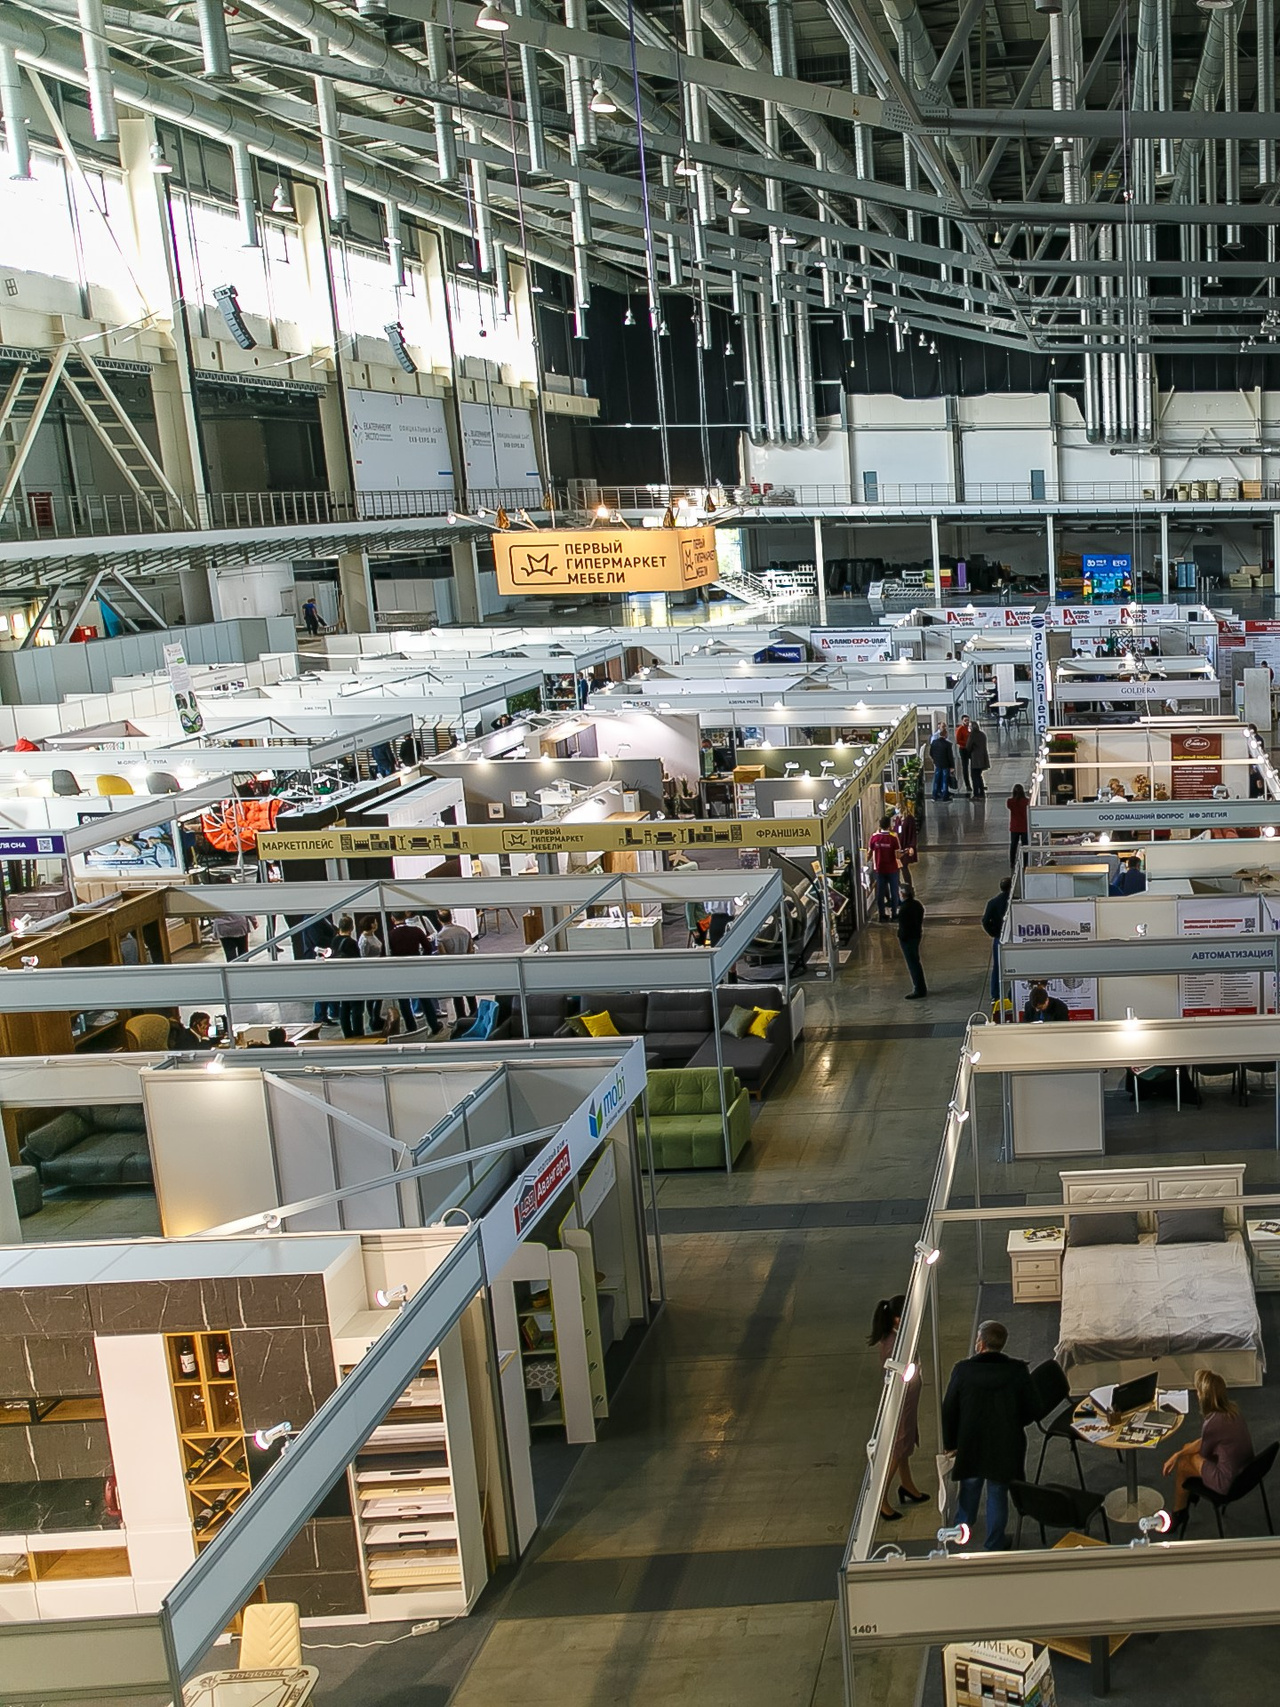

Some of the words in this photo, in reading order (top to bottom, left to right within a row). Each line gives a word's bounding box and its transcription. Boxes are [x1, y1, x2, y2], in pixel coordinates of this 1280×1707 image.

[564, 539, 623, 555] ПЕРВЫЙ
[566, 556, 667, 570] ГИПЕРМАРКЕТ
[568, 572, 626, 585] МЕБЕЛИ
[1120, 686, 1156, 695] GOLDERA
[1115, 812, 1156, 822] ДОМАШНИЙ
[1156, 812, 1185, 820] ВОПРОС
[1188, 812, 1201, 820] МФ
[1201, 811, 1228, 819] ЭЛЕГИЯ
[530, 826, 562, 836] ПЕРВЫЙ
[755, 828, 812, 841] ФРАНШИЗА
[11, 841, 27, 849] СНА
[261, 838, 335, 851] МАРКЕТПЛЕЙС
[530, 835, 584, 843] ГИПЕРМАРКЕТ
[531, 843, 563, 851] МЕБЕЛИ
[1018, 924, 1050, 937] bCAD
[1051, 929, 1080, 937] Мебель
[1191, 949, 1274, 961] АВТОМАТИЗАЦИЯ
[603, 1066, 626, 1118] mobi
[537, 1153, 569, 1200] Авангард
[852, 1624, 877, 1635] 1401
[971, 1640, 1026, 1659] ЛМЕКО
